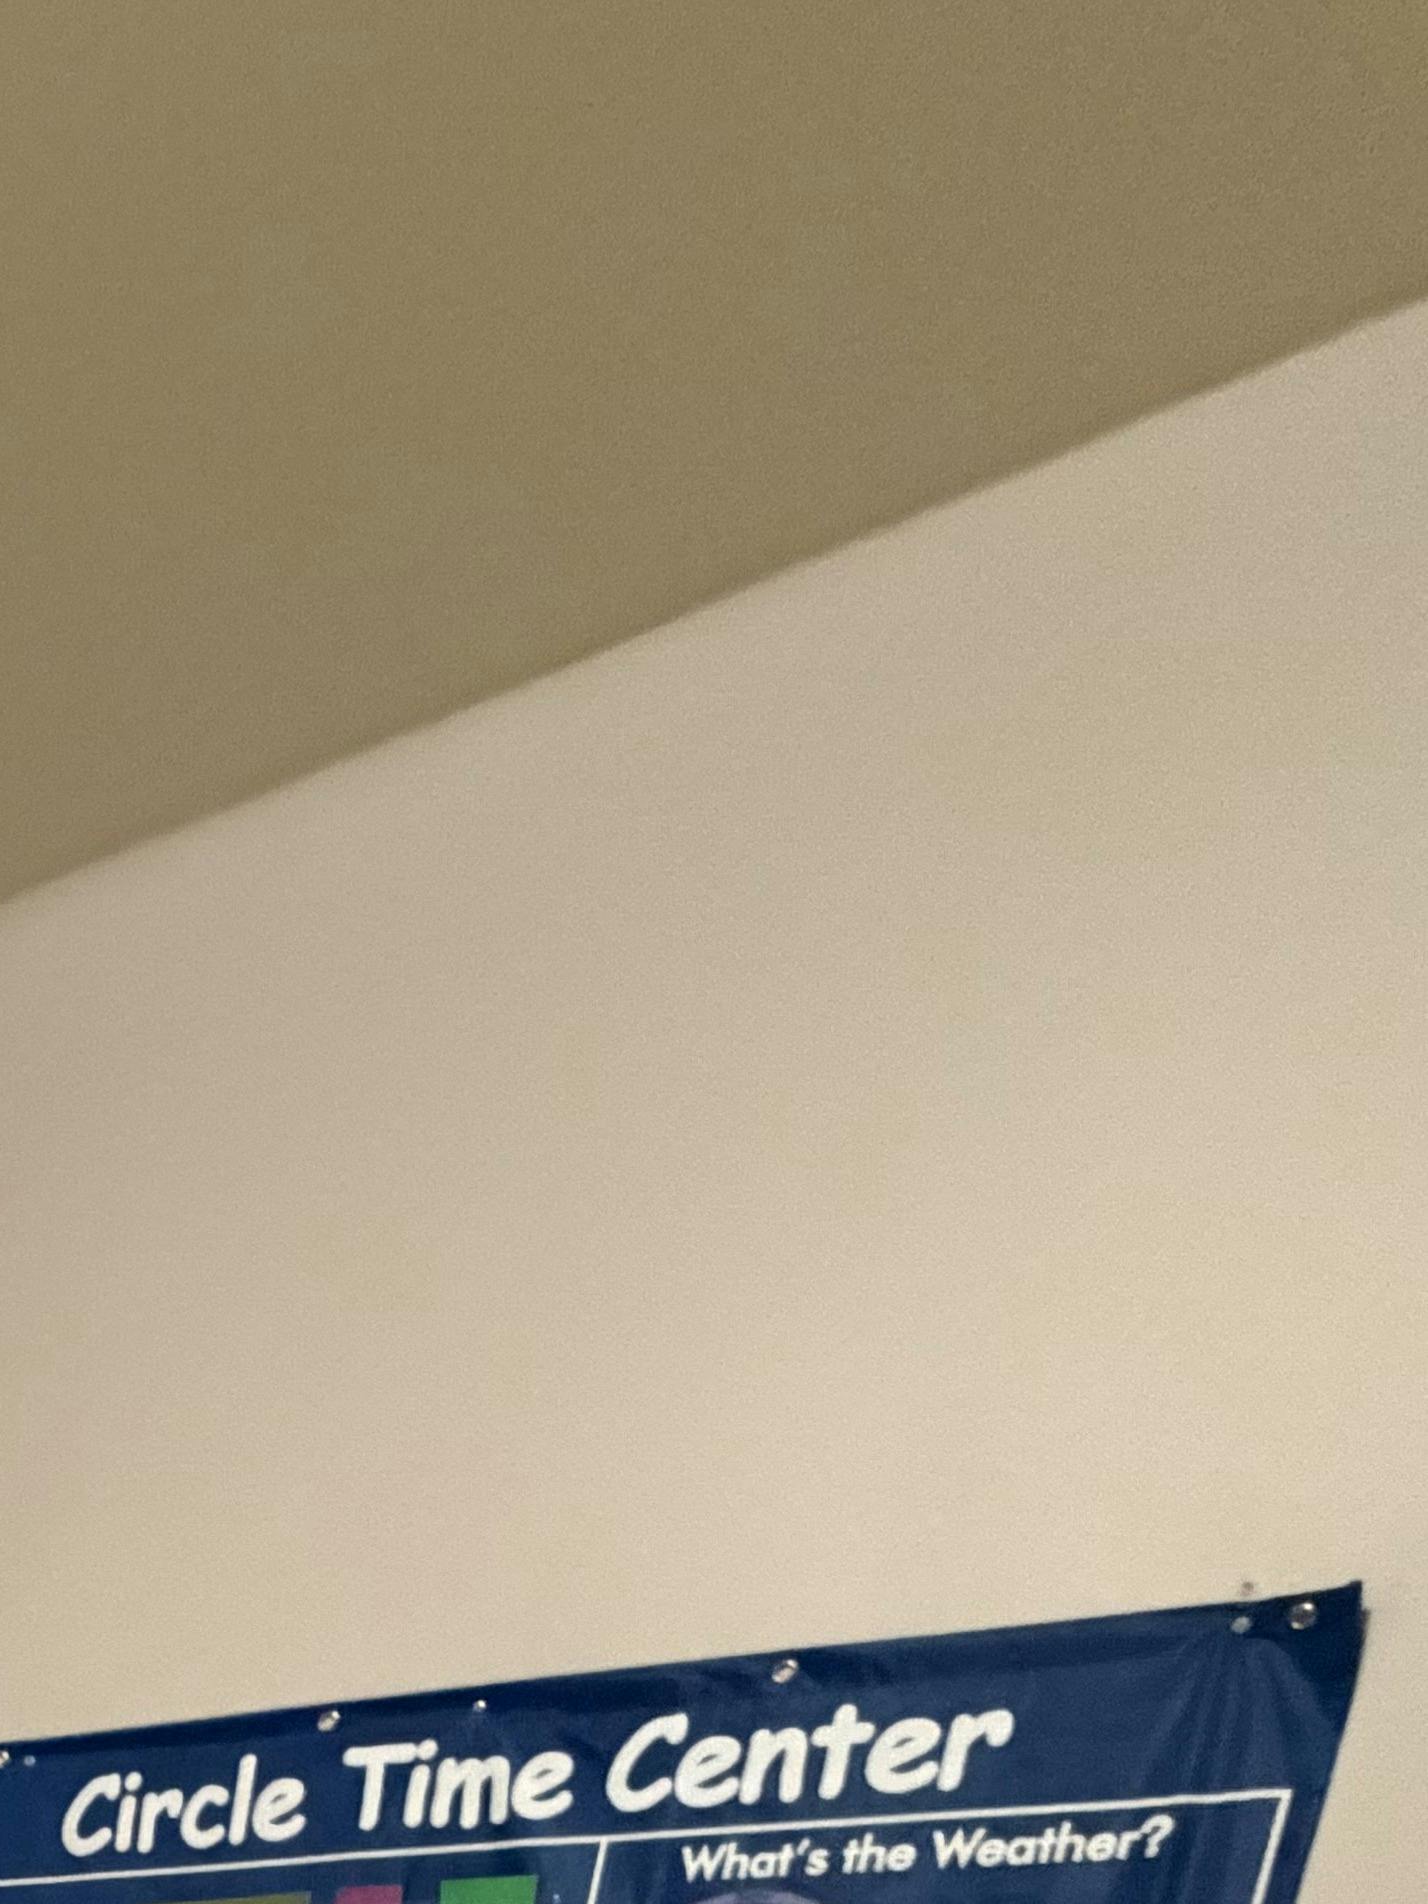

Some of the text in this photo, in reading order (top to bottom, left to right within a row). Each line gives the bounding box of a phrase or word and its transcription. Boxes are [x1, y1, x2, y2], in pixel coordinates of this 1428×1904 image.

[61, 1703, 1015, 1857] Circle Time Center
[681, 1814, 1175, 1883] What's the Weather?
